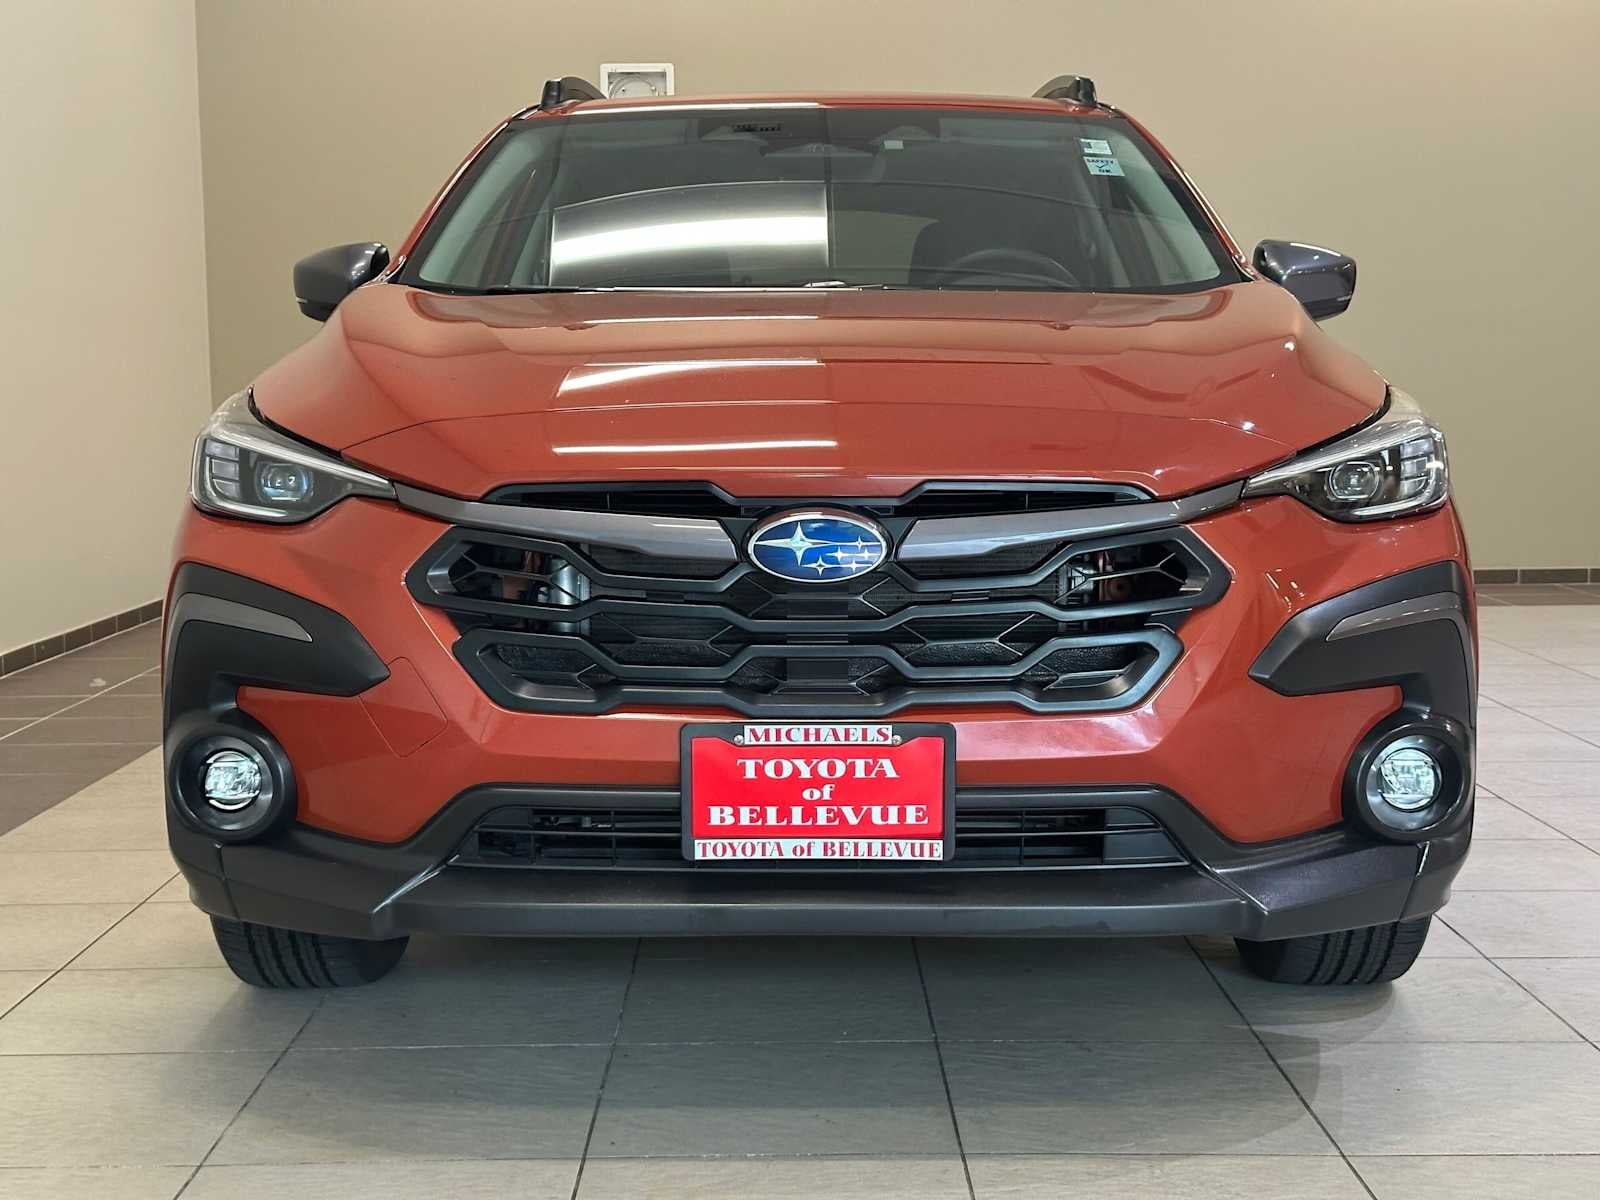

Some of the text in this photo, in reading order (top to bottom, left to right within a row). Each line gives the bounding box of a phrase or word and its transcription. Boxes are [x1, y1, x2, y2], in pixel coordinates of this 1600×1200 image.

[748, 727, 890, 743] MICHAELS
[737, 758, 900, 779] TOYOTA
[802, 784, 836, 801] of
[707, 804, 930, 826] BELLEVUE
[697, 841, 942, 858] TOYOTA of BELLEVUE
